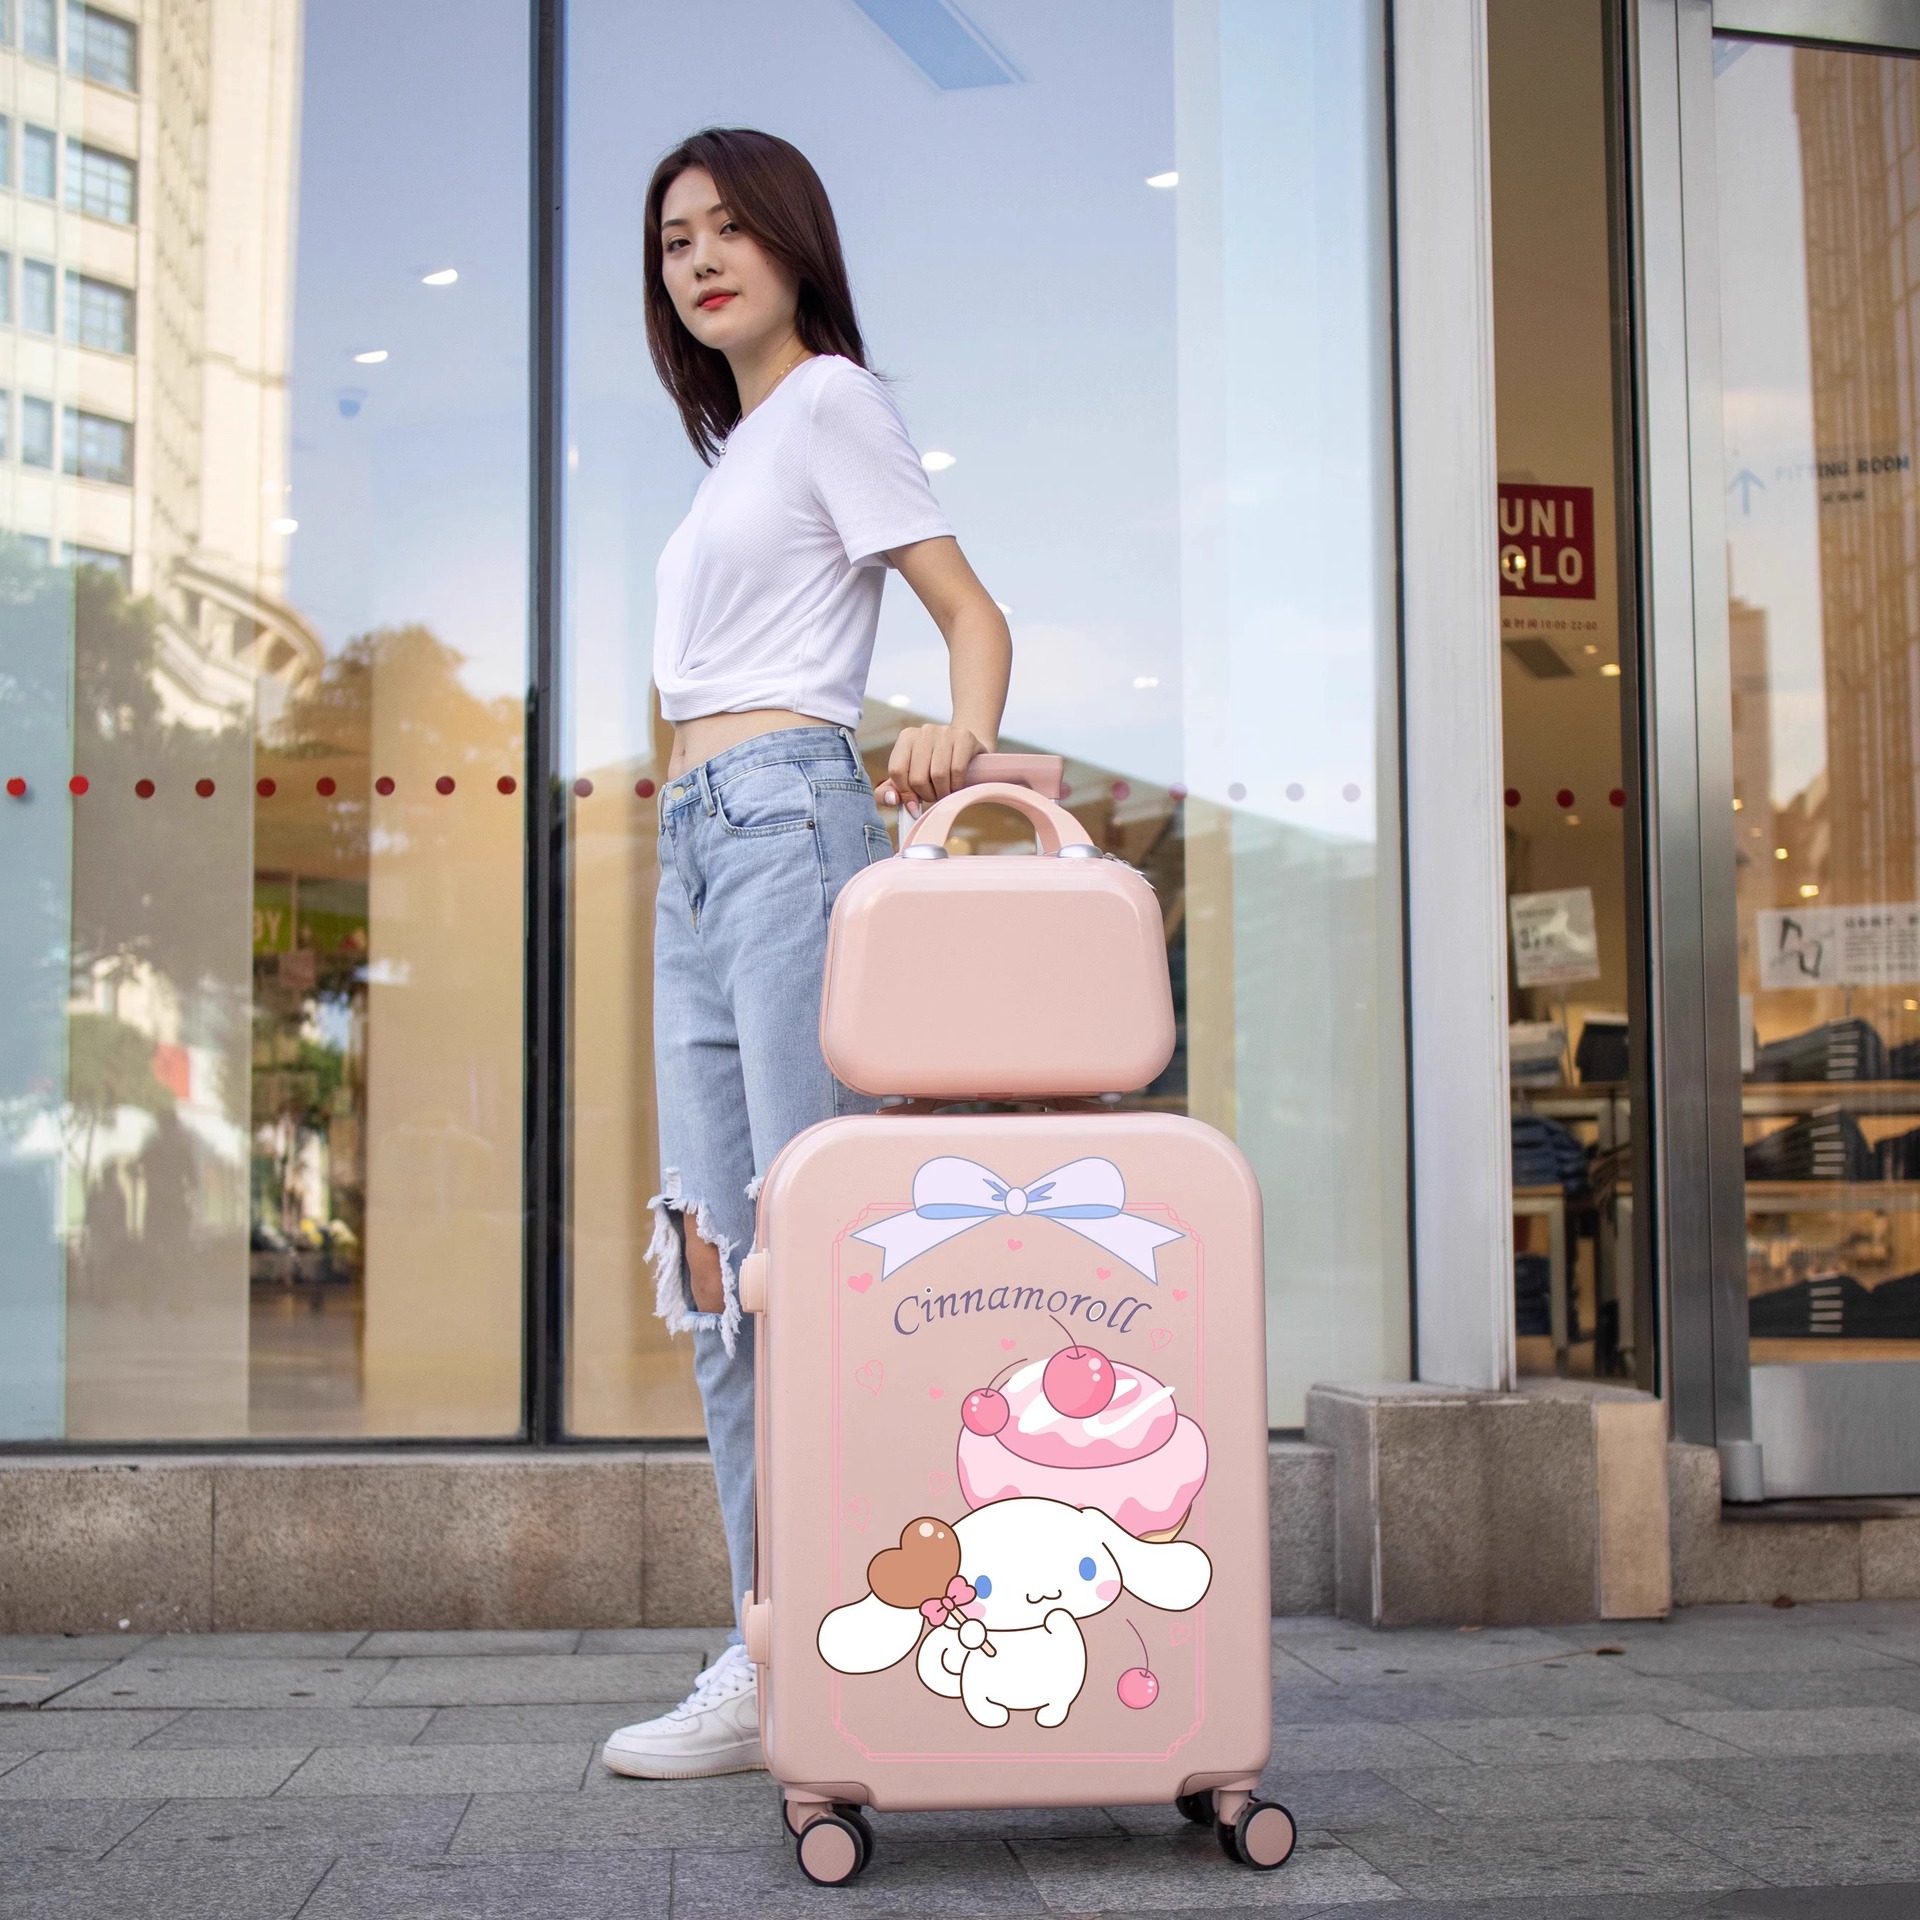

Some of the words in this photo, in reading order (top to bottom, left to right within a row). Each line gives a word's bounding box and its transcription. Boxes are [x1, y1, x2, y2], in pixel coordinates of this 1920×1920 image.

[1499, 497, 1574, 538] UNI
[1500, 545, 1582, 590] QLO
[894, 1286, 1152, 1335] Cinnamoroll
